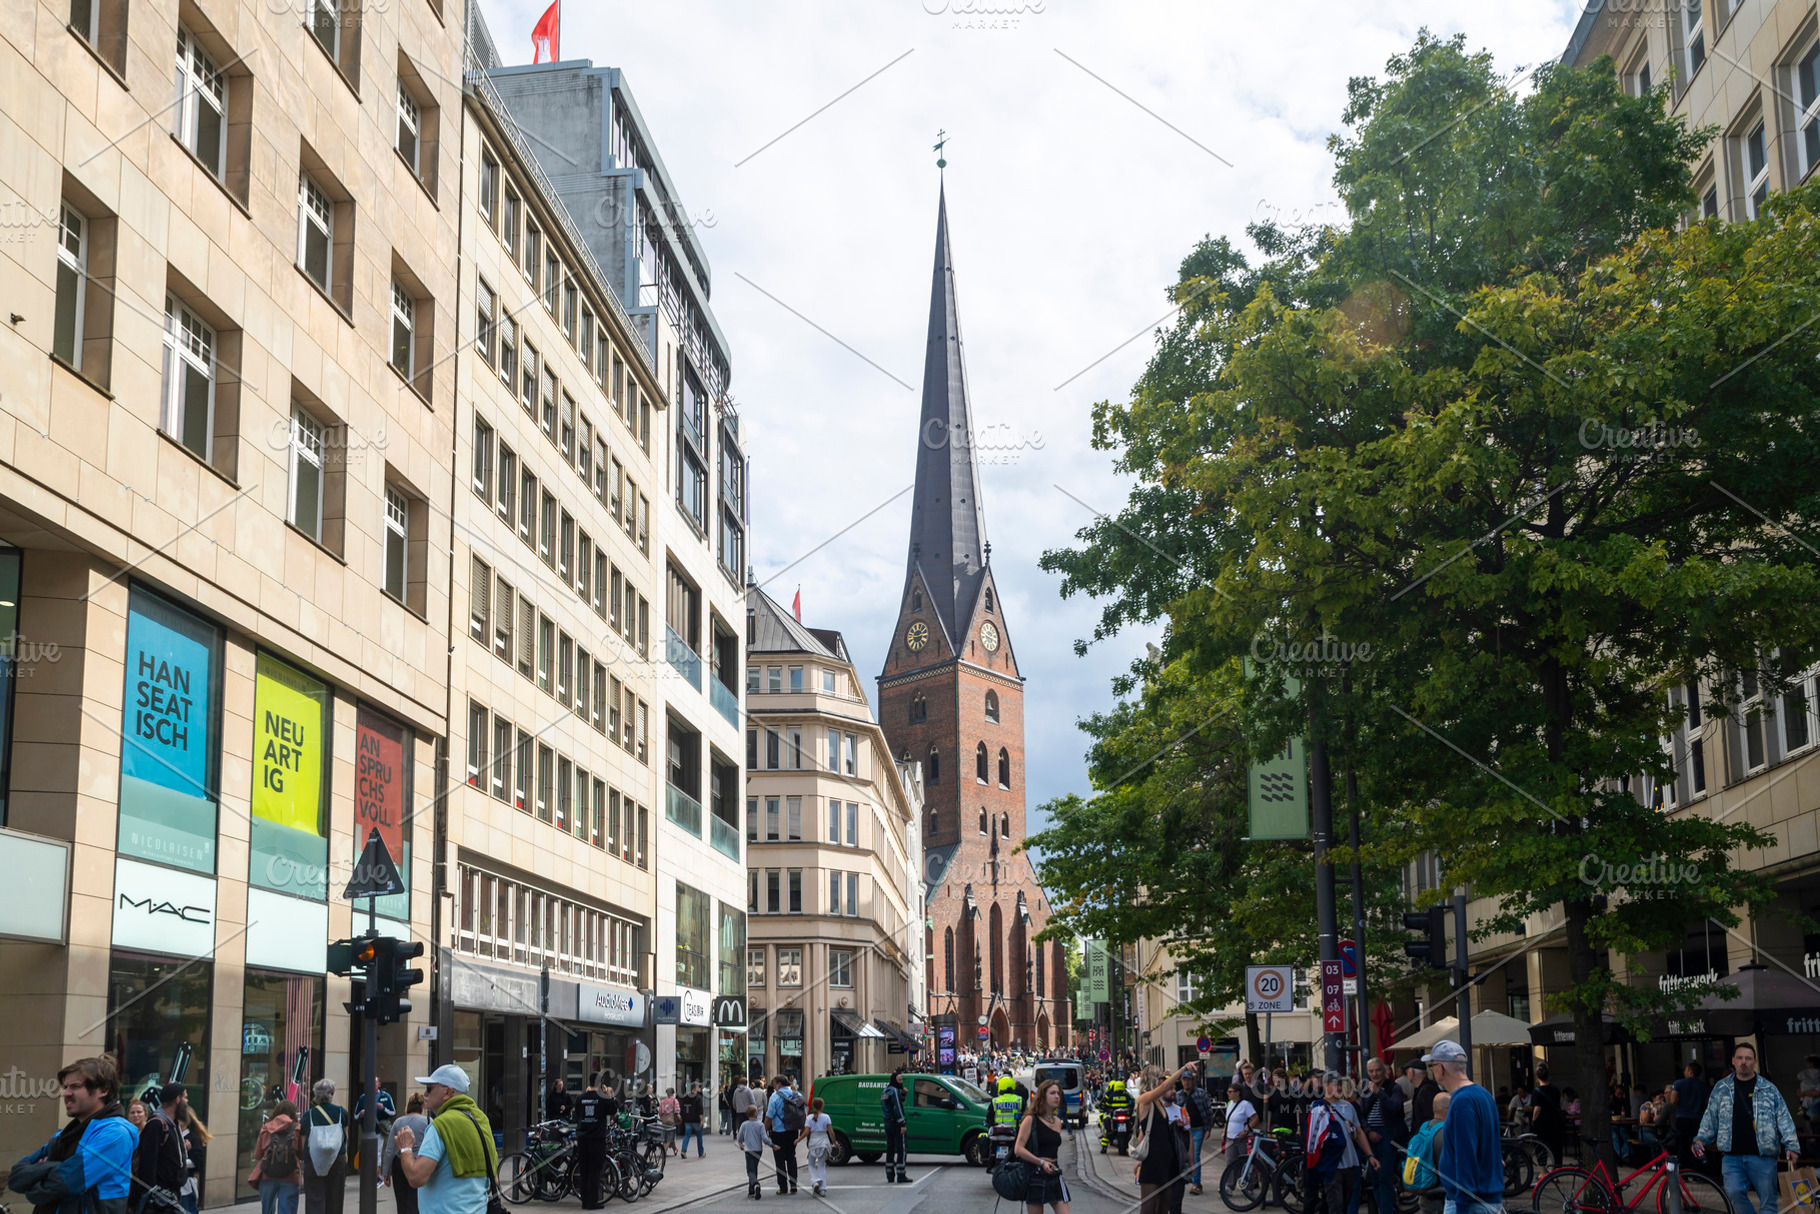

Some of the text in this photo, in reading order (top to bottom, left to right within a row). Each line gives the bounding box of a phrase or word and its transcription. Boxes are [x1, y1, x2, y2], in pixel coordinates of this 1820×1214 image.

[138, 650, 190, 695] HAN
[136, 680, 192, 723] SEAT
[136, 710, 188, 751] ISCH
[265, 710, 304, 748] NEU
[263, 739, 302, 773] ART
[360, 732, 380, 758] AN
[264, 768, 284, 793] IG
[360, 756, 392, 784] SPRU
[359, 777, 385, 804] CHS
[358, 798, 392, 828] VOLL
[1326, 965, 1339, 974] 03
[1261, 978, 1278, 992] 20
[1327, 985, 1339, 994] 07
